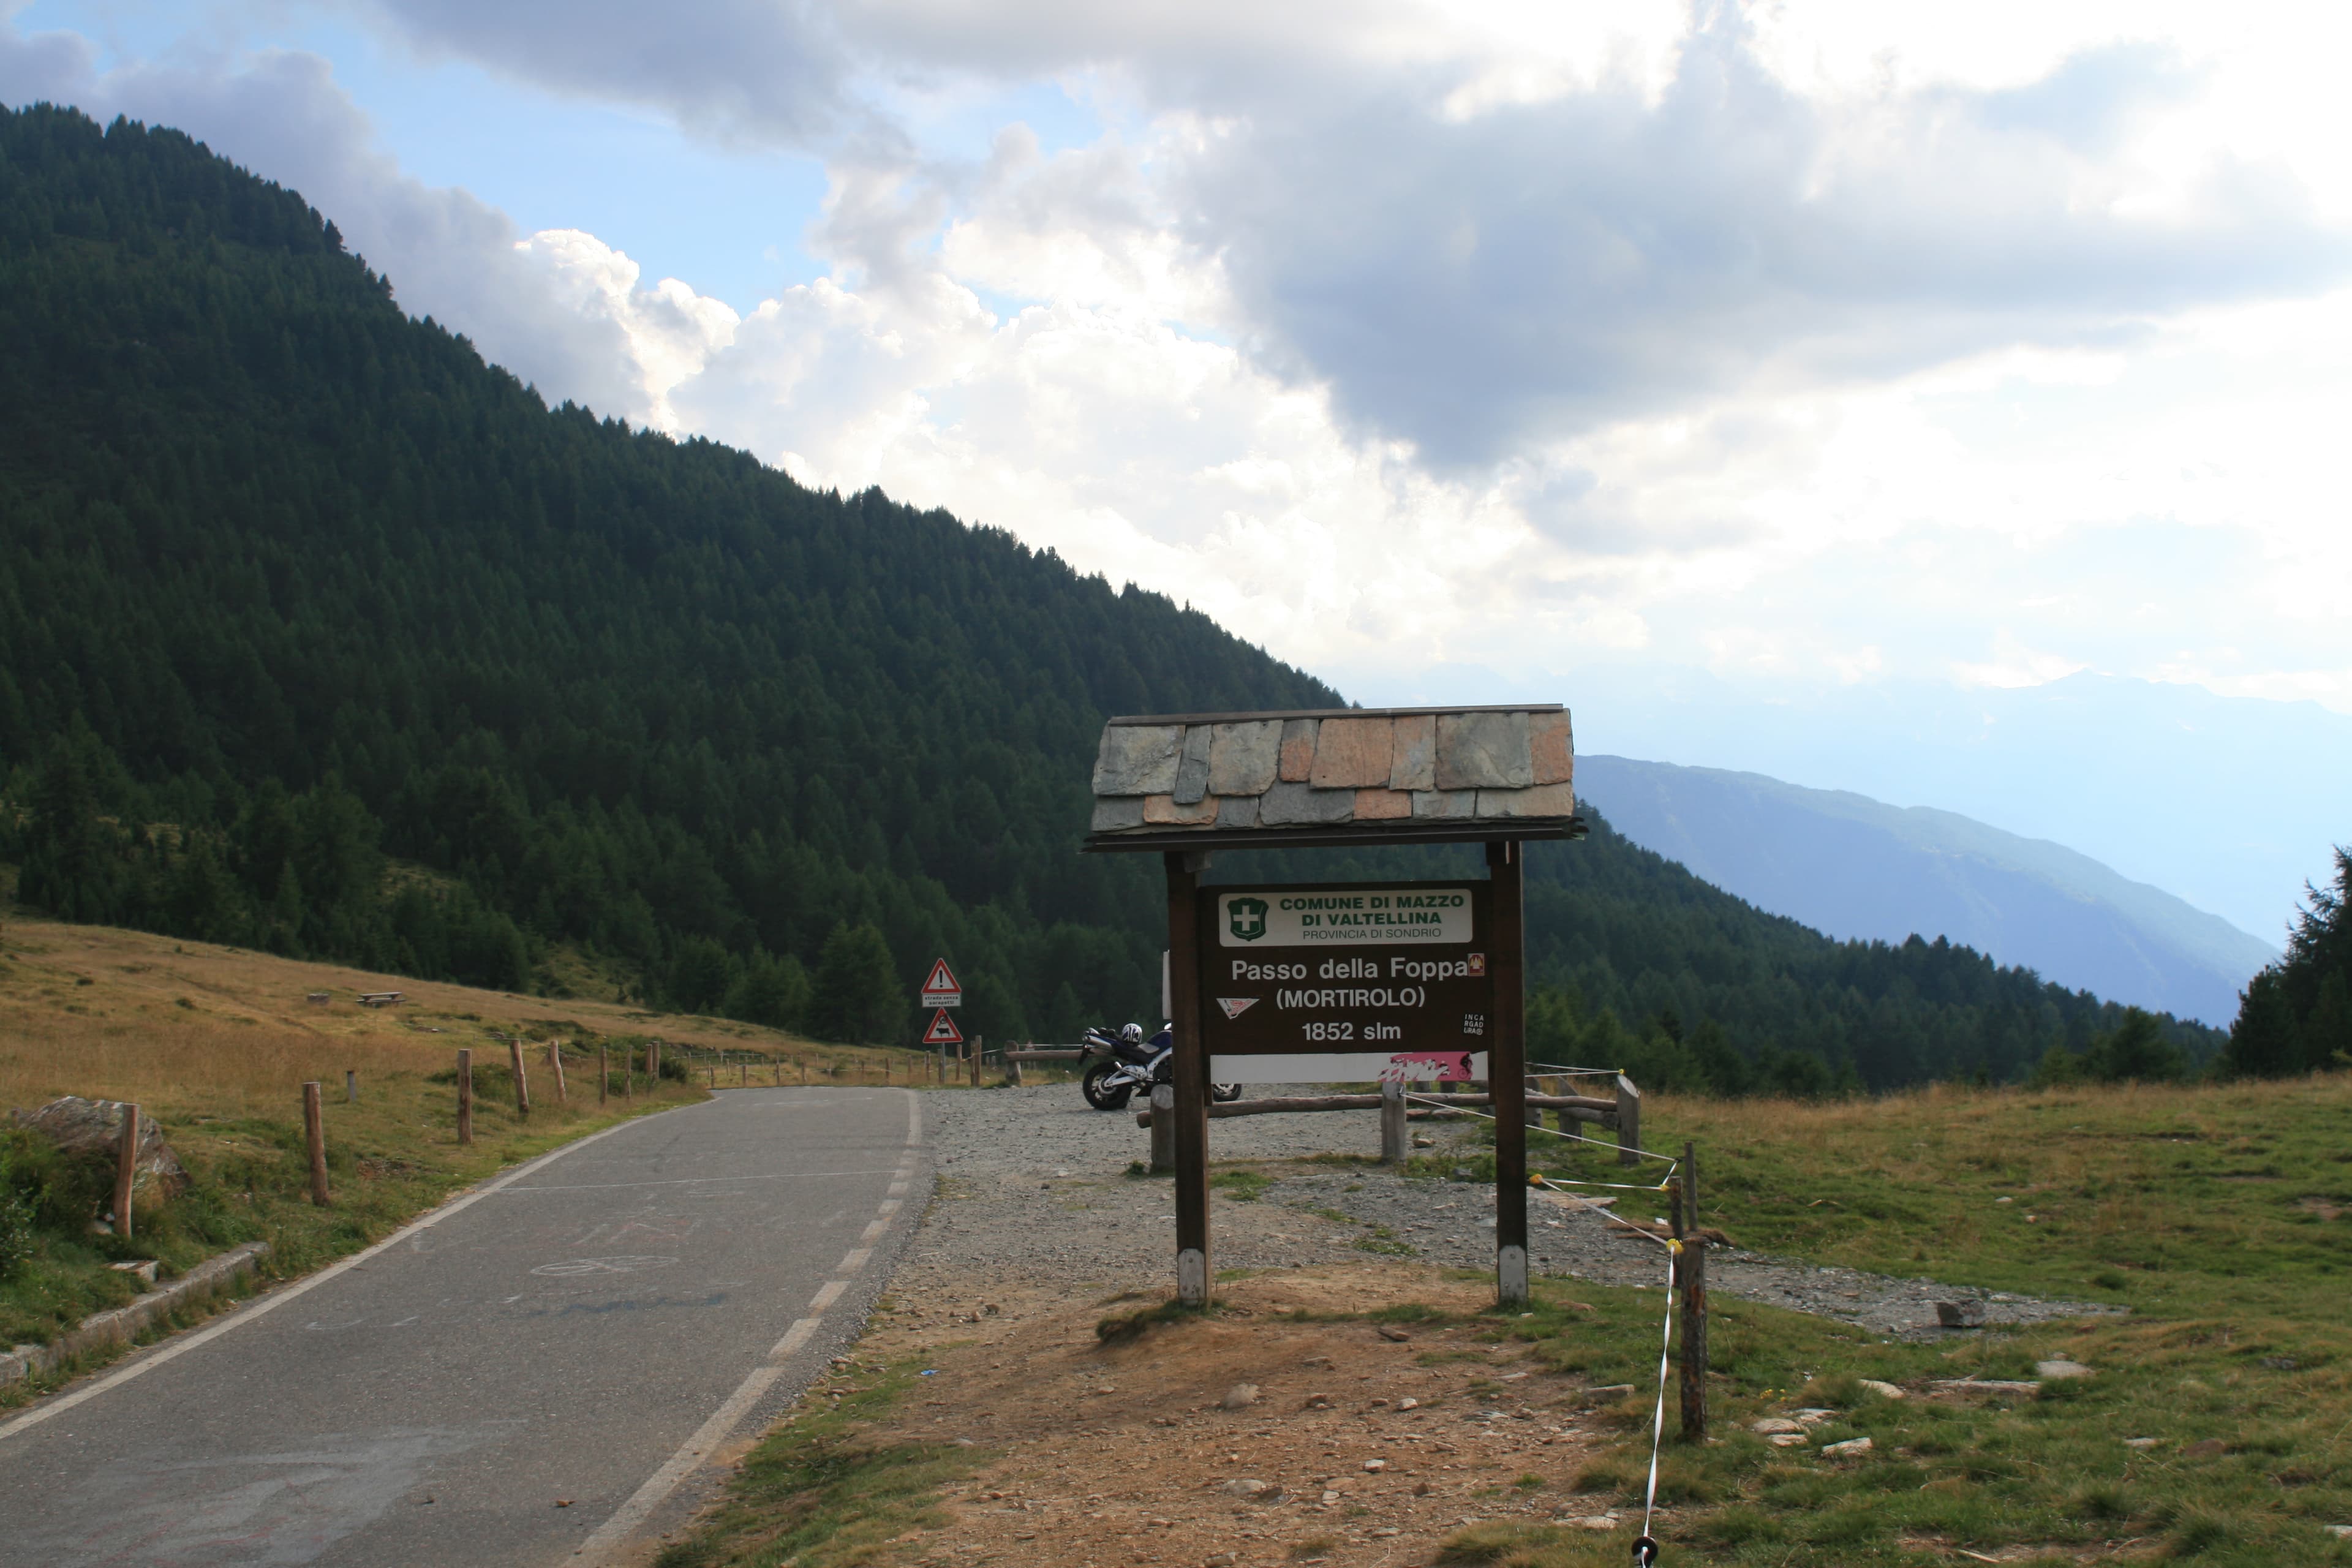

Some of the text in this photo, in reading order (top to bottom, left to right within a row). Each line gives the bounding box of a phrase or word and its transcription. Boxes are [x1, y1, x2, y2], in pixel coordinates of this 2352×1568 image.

[1280, 895, 1464, 910] COMUNE DI MAZZO
[1302, 912, 1442, 926] DI VALTELLINA
[1303, 928, 1441, 939] PROVINCIA DI SONDRIO
[1232, 957, 1468, 981] Passo della Foppa
[1276, 986, 1425, 1009] (MORTIROLO)
[1302, 1022, 1401, 1040] 1852 slm
